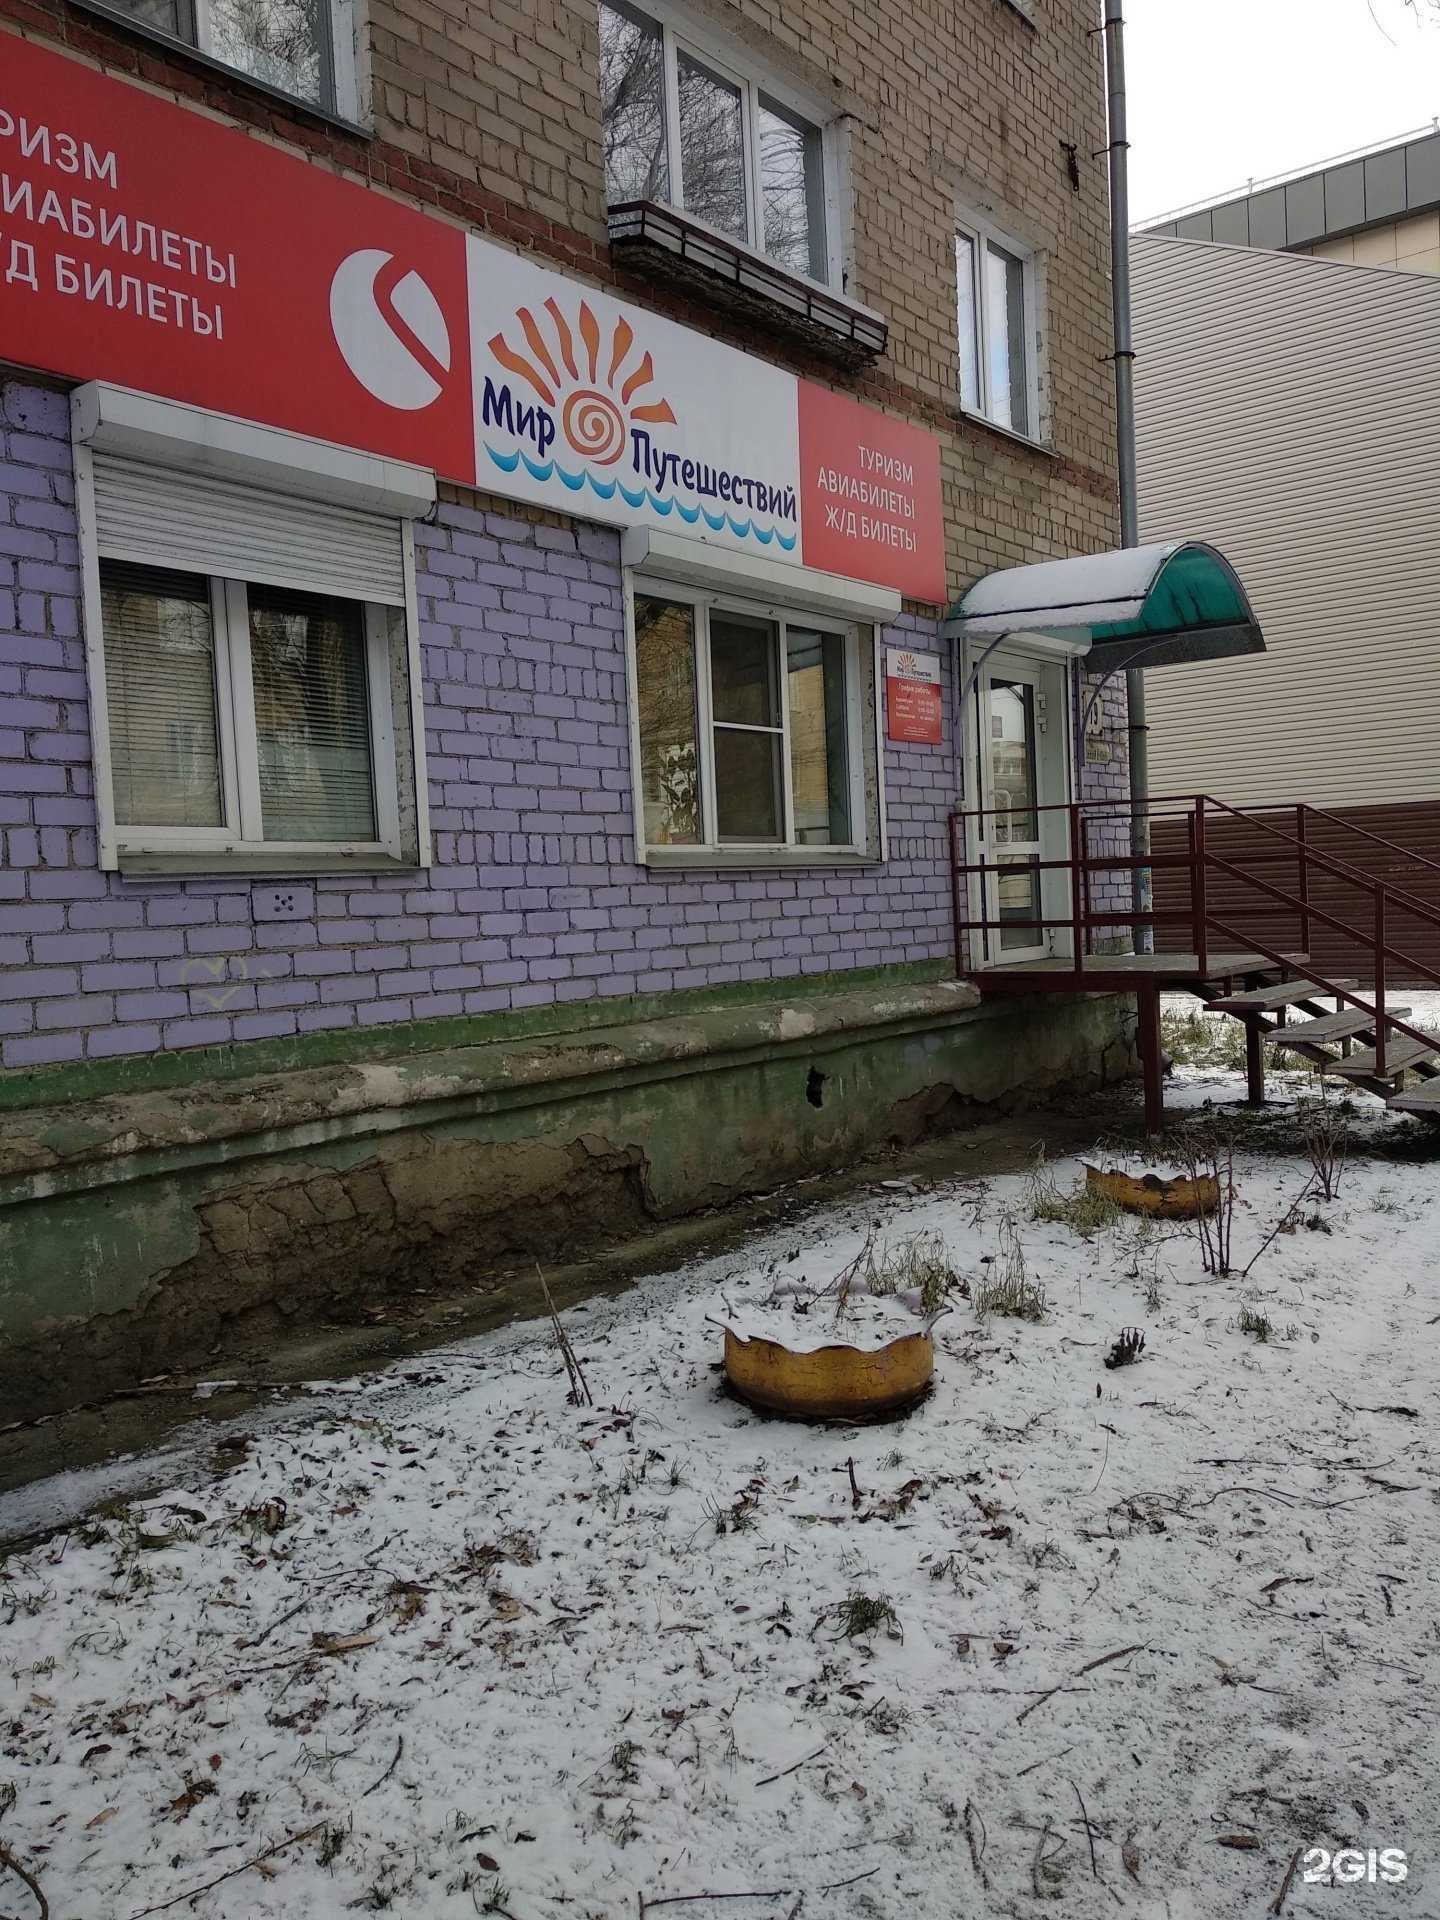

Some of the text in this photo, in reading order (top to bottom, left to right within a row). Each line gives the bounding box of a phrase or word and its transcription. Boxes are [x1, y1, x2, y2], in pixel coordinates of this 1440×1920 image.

[1, 172, 237, 288] ИАБИЛЕТЫ
[55, 253, 223, 340] БИЛЕТЫ
[482, 376, 555, 457] Мир
[630, 428, 798, 522] Путешествий
[817, 466, 916, 520] АВИАБИЛЕТЫ
[858, 446, 914, 487] ТУРИЗМ
[825, 504, 917, 553] Ж/Д БИЛЕТЫ
